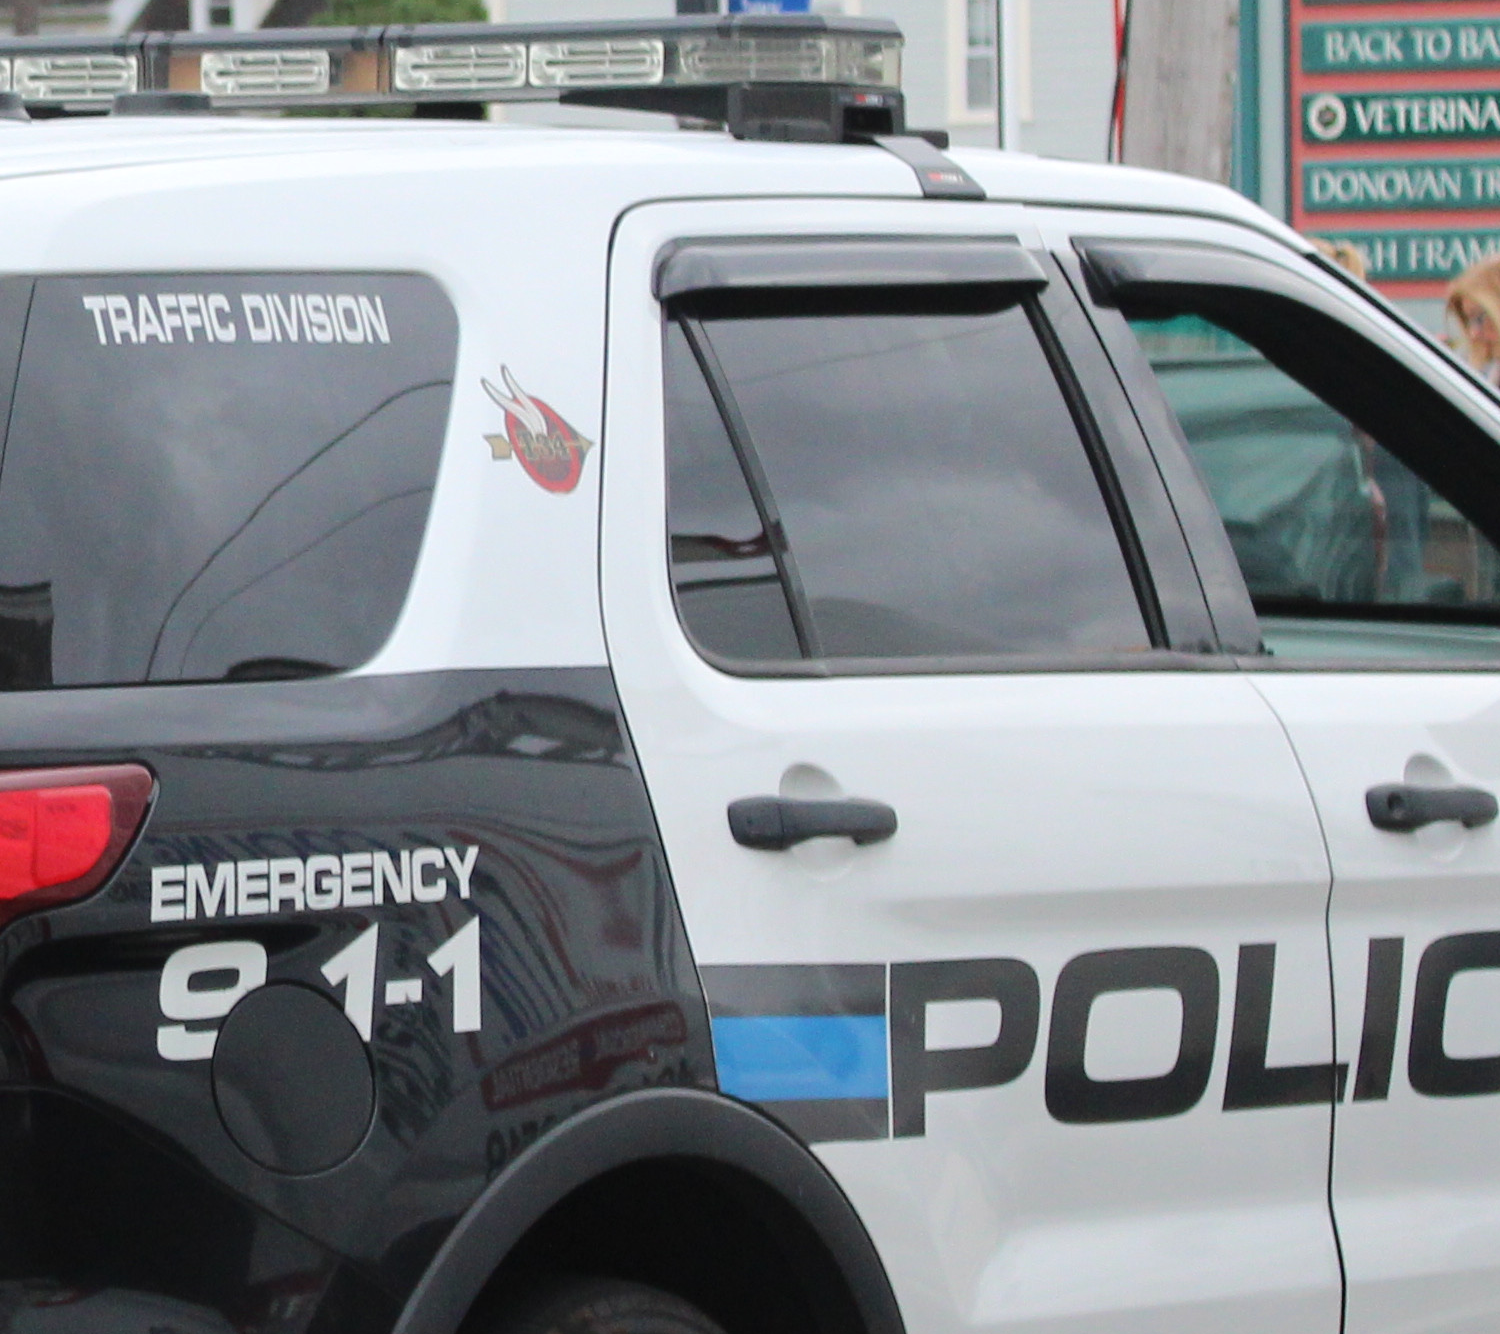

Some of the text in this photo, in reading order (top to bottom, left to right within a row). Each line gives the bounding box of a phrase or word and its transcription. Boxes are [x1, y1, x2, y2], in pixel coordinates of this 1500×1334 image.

[1324, 29, 1404, 63] BACK
[1410, 26, 1451, 60] TO
[1311, 166, 1462, 203] DONOVAN
[83, 293, 391, 345] TRAFFIC DIVISION
[150, 845, 479, 922] EMERGENCY
